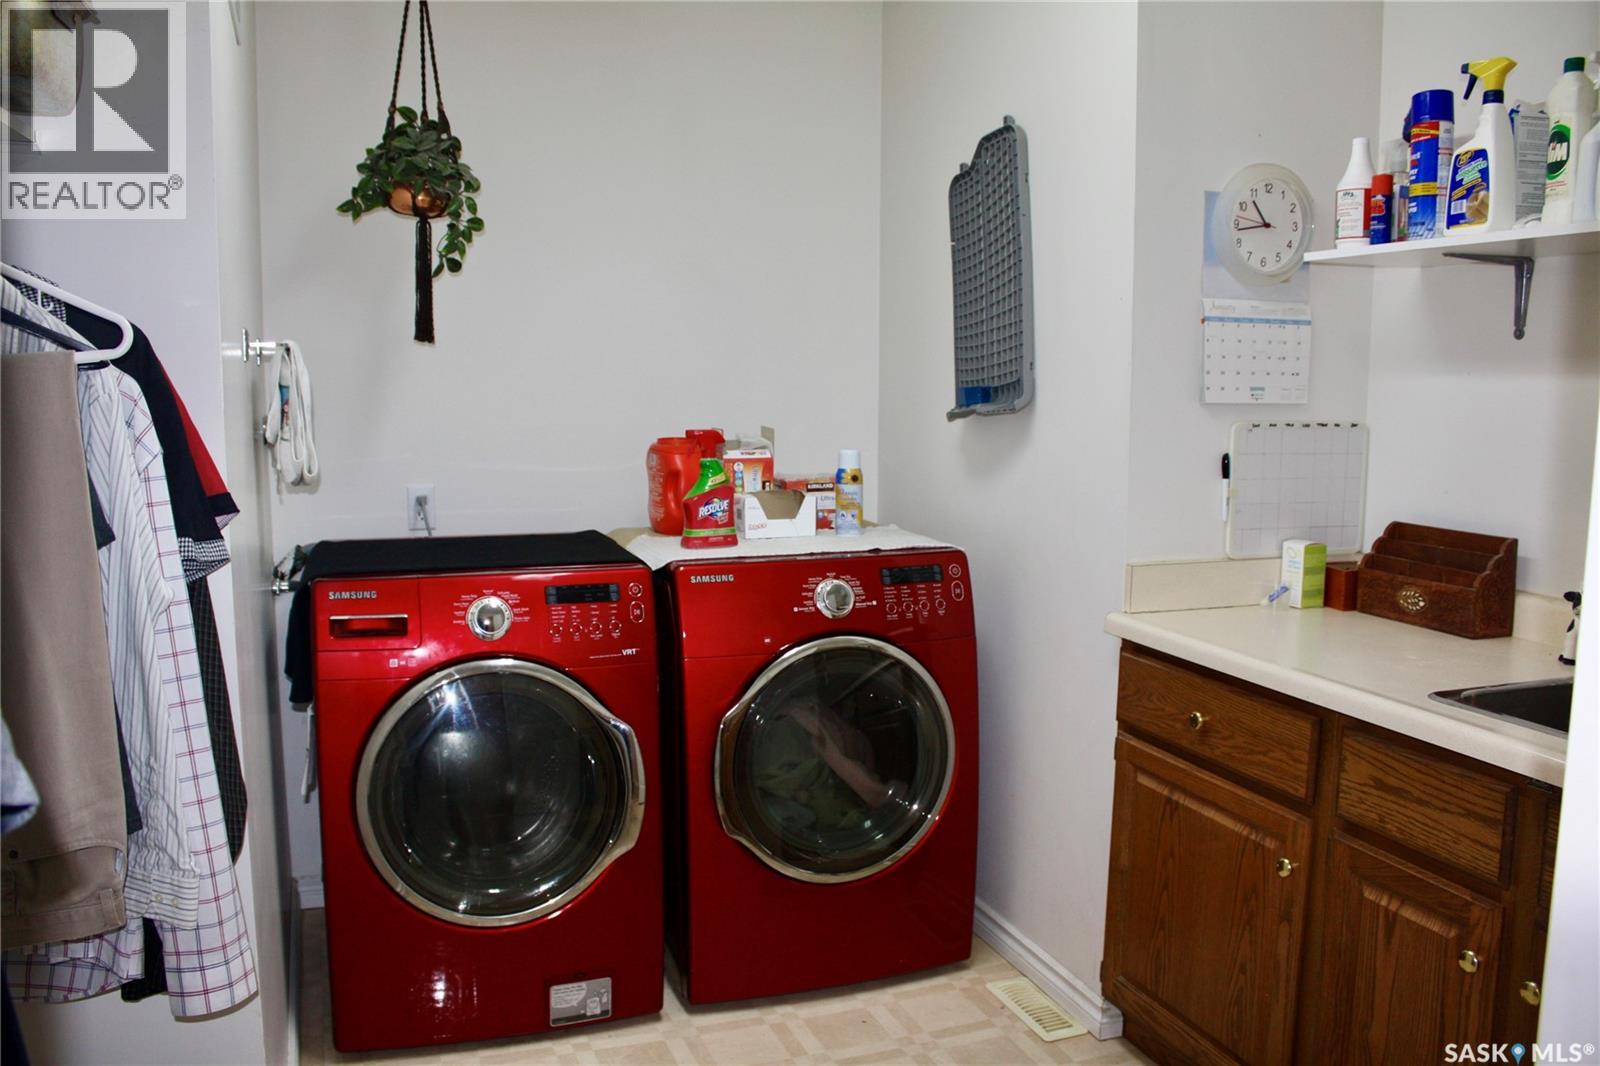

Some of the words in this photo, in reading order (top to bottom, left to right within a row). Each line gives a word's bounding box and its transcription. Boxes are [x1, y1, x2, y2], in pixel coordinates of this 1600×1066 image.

[1250, 188, 1258, 198] 11
[1264, 183, 1273, 194] 12
[1281, 190, 1286, 200] 1
[1239, 201, 1248, 212] 10
[1290, 203, 1296, 213] 2
[1233, 219, 1240, 230] 9
[1292, 221, 1298, 232] 3
[1236, 238, 1242, 249] 8
[1286, 240, 1292, 249] 4
[1247, 251, 1252, 261] 7
[1275, 252, 1282, 263] 5
[1260, 257, 1266, 267] 6
[698, 500, 729, 518] RESOLVE
[690, 574, 734, 584] SAMSUNG
[328, 590, 377, 600] SAMSUNG
